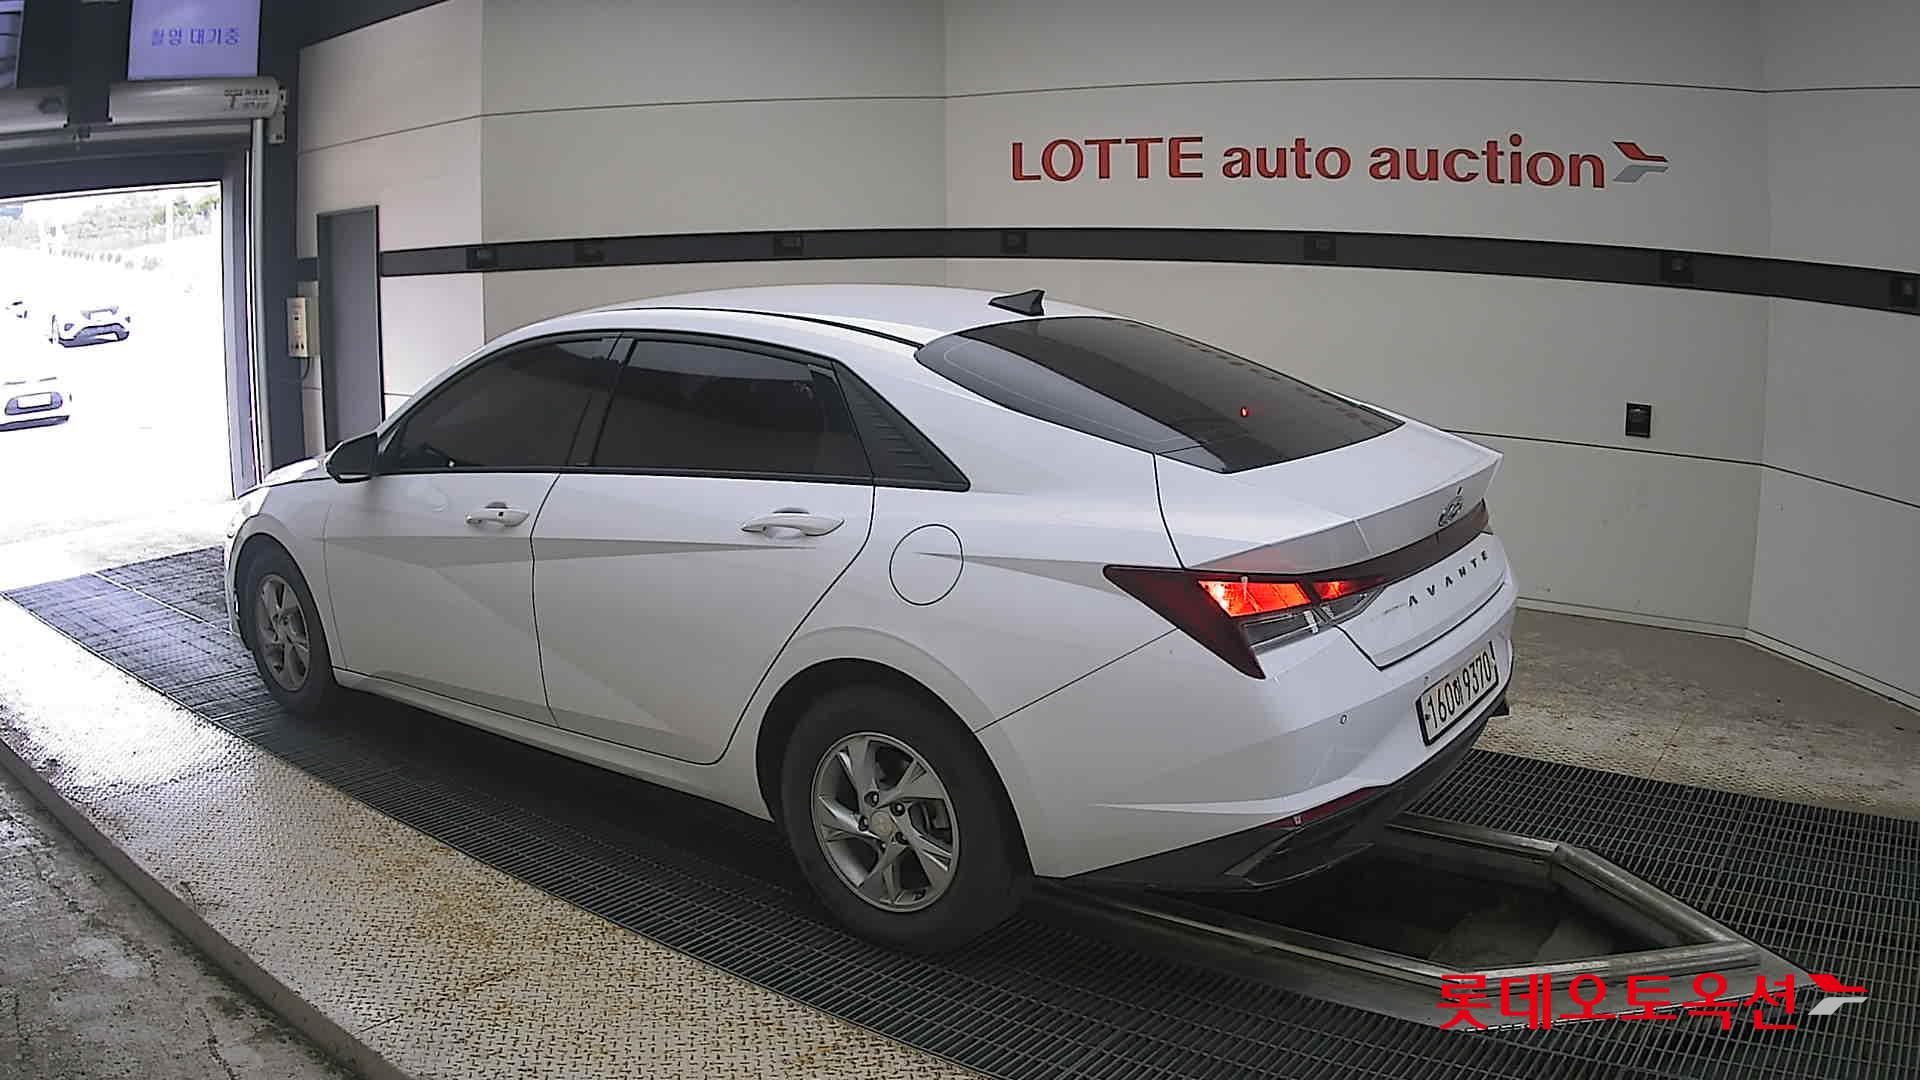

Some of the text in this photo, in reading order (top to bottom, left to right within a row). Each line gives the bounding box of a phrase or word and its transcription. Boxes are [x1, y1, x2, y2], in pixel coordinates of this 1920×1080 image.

[1012, 134, 1606, 188] LOTTE auto auction
[1408, 550, 1489, 606] AVANTE
